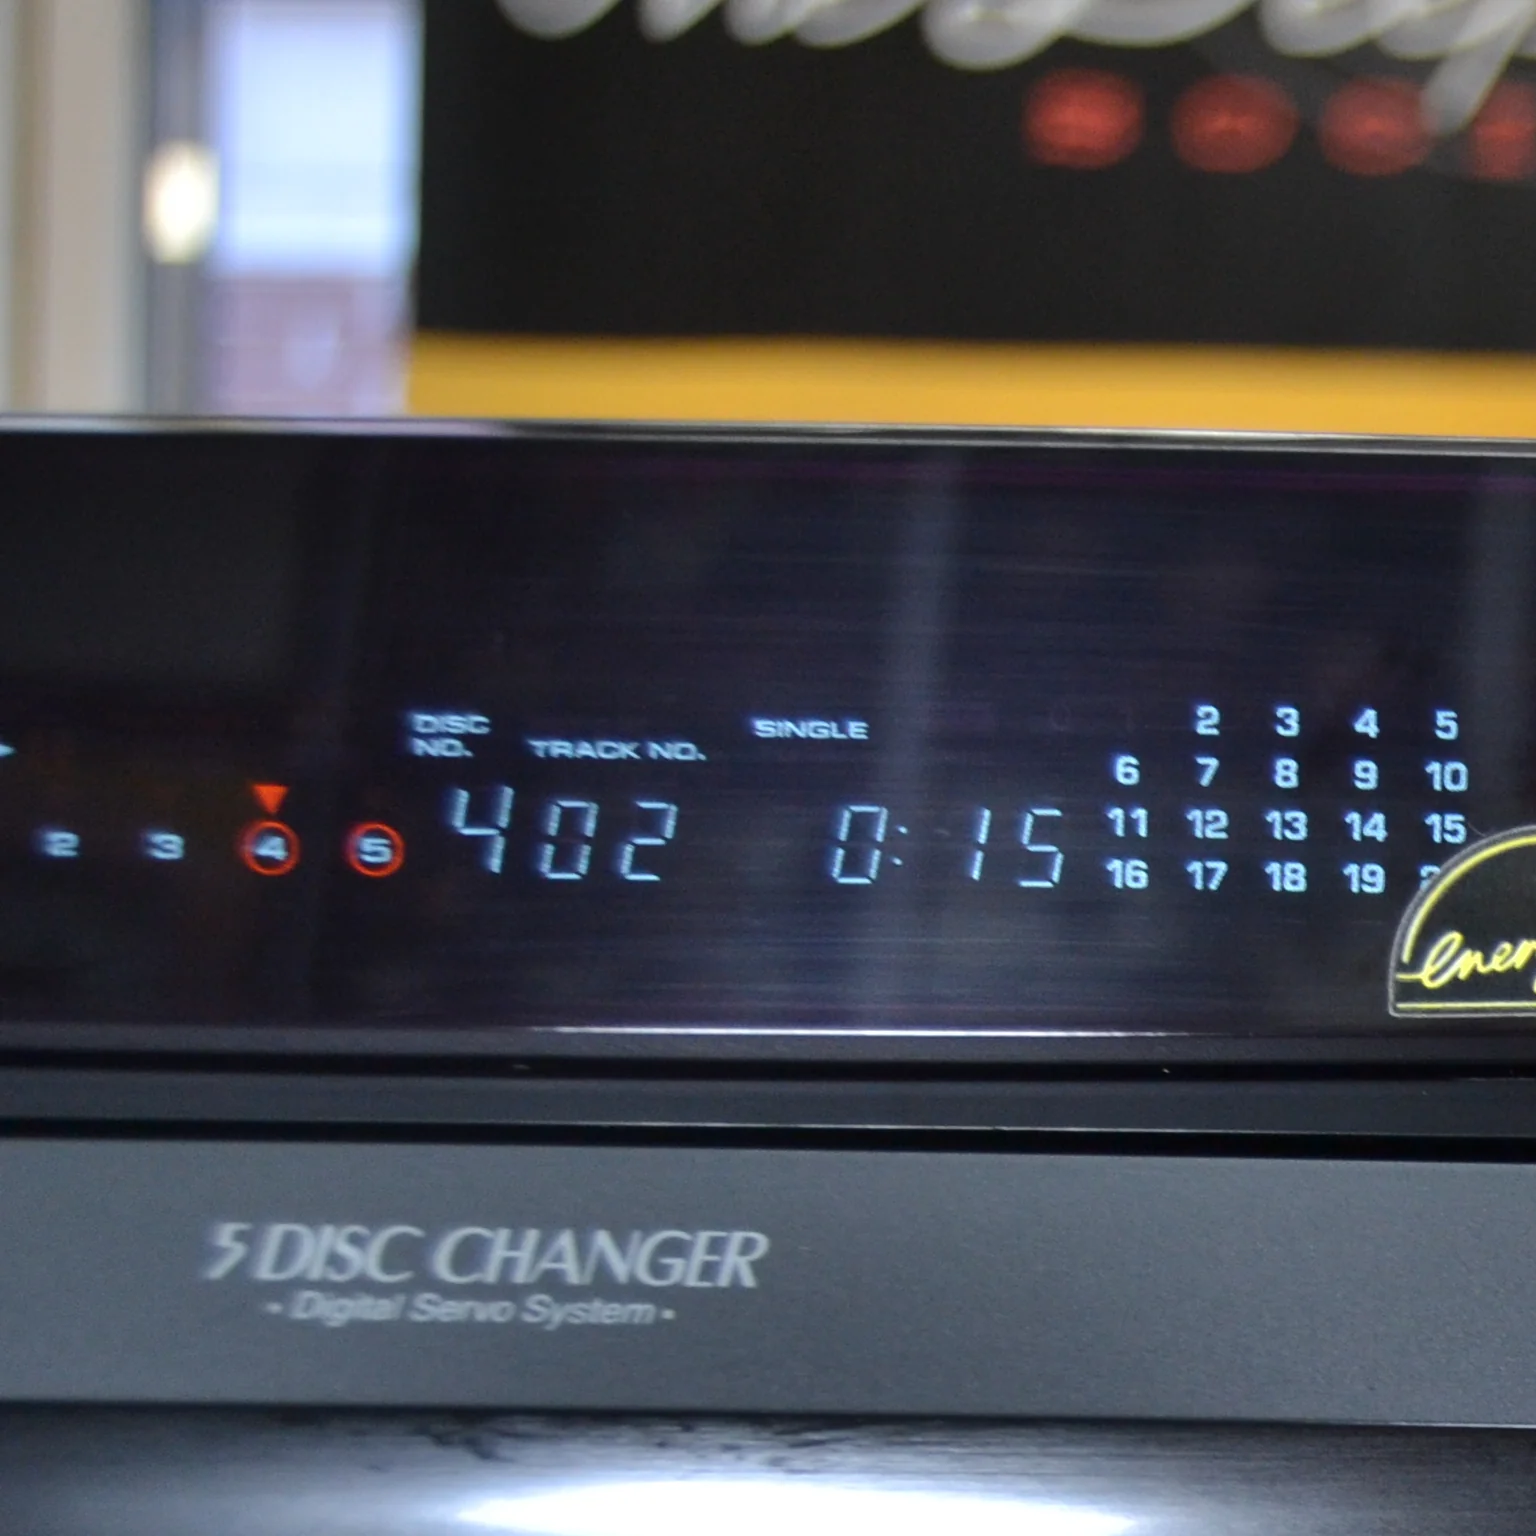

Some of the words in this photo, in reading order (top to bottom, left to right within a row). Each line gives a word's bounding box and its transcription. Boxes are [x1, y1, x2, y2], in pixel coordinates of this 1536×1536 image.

[410, 713, 491, 735] DISC
[753, 719, 869, 740] SINGLE
[1195, 706, 1220, 736] 2
[1274, 707, 1300, 737] 3
[1354, 708, 1380, 739] 4
[1434, 710, 1459, 740] 5
[410, 737, 474, 758] NO.
[526, 739, 642, 760] TRACK
[647, 740, 707, 761] NO.
[1115, 755, 1141, 786] 6
[1195, 756, 1220, 787] 7
[1273, 758, 1299, 789] 8
[1353, 760, 1379, 791] 9
[1425, 761, 1469, 793] 10
[1106, 807, 1149, 838] 11
[1186, 808, 1230, 839] 12
[1265, 810, 1309, 841] 13
[1344, 811, 1388, 843] 14
[1425, 813, 1467, 844] 15
[44, 830, 81, 858] 2
[147, 832, 186, 861] 3
[254, 835, 290, 862] 4
[357, 837, 394, 864] 5
[1106, 859, 1150, 889] 16
[1186, 860, 1230, 891] 17
[1265, 861, 1308, 893] 18
[1344, 863, 1387, 894] 19
[253, 1222, 426, 1284] DISC
[433, 1226, 768, 1289] CHANGER
[287, 1289, 406, 1328] Digital
[407, 1291, 519, 1324] Servo
[520, 1293, 657, 1332] System
